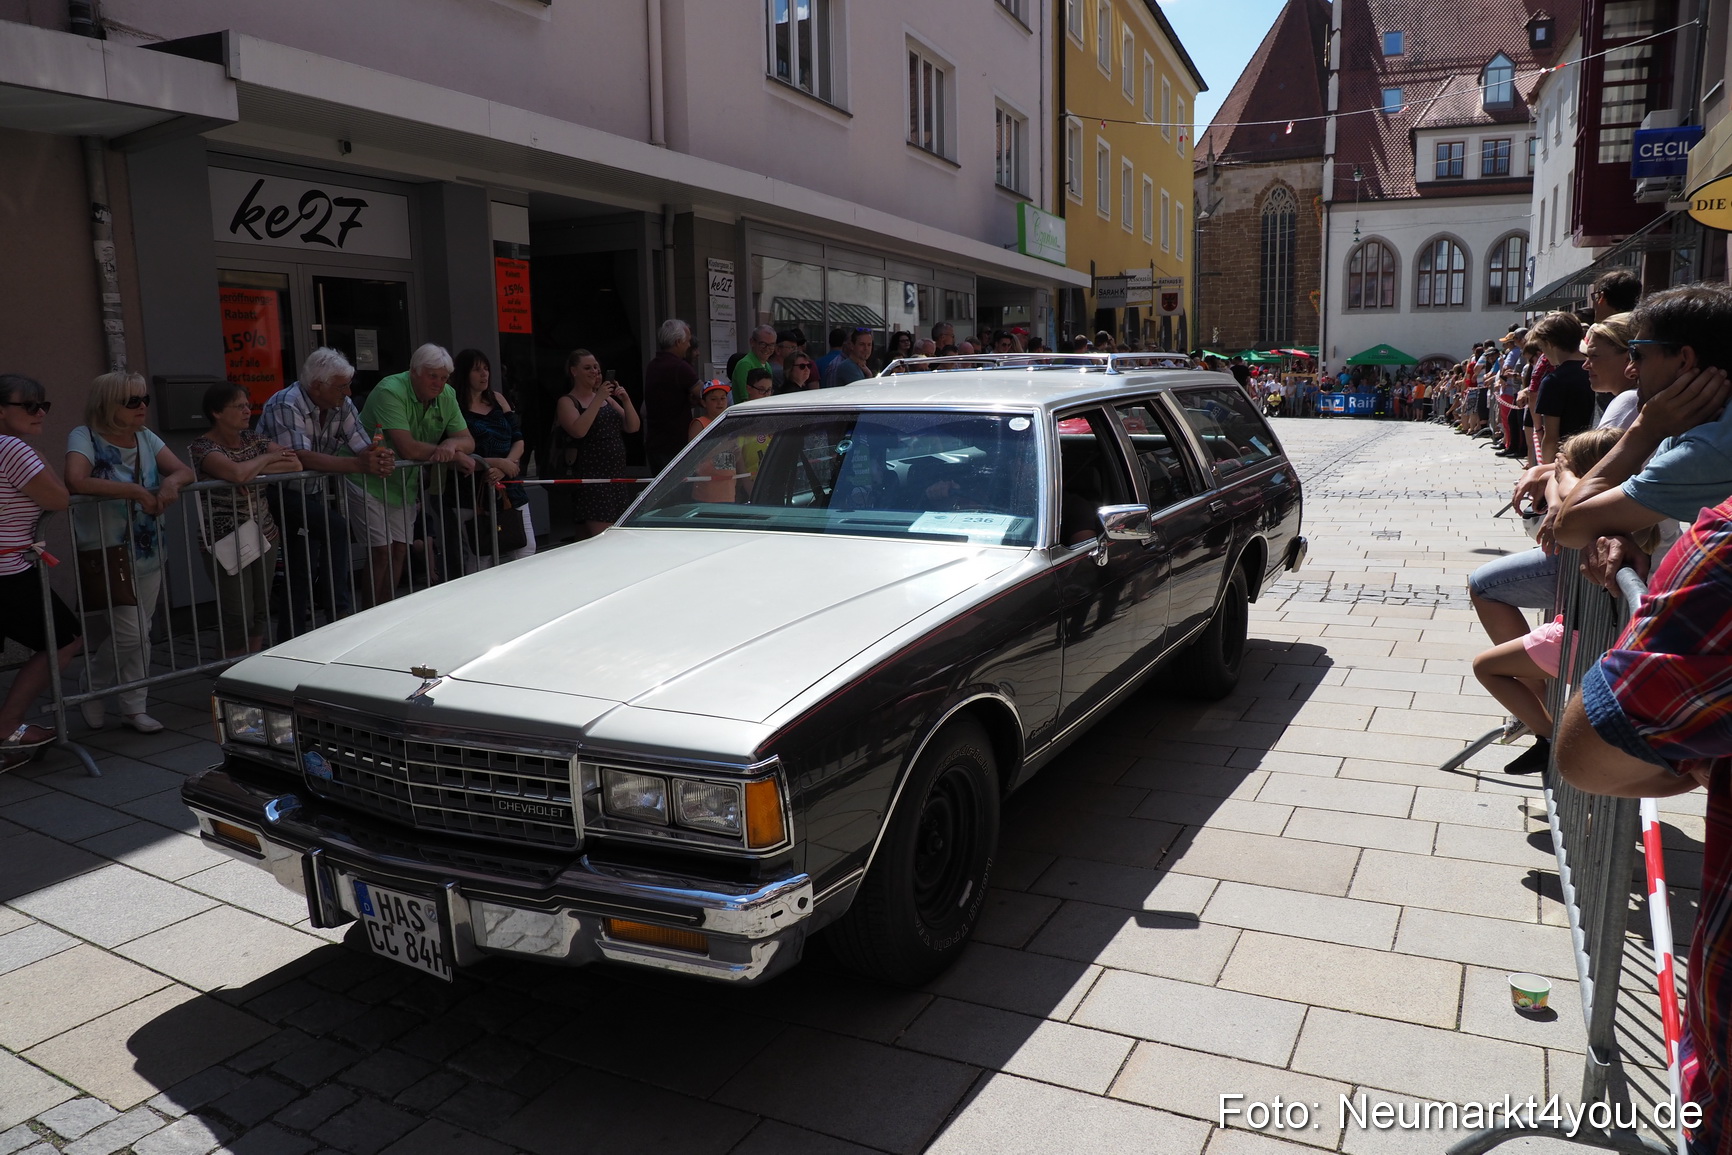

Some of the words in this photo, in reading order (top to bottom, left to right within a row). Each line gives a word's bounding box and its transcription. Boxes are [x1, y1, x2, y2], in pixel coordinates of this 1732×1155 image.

[1639, 141, 1689, 157] CECIL
[1696, 198, 1727, 211] DIE
[229, 178, 369, 249] ke27
[504, 284, 523, 296] 15%
[710, 275, 733, 292] ke27
[219, 291, 273, 305] eröffnungs-
[1098, 288, 1119, 296] SARAH
[1120, 287, 1125, 295] K
[224, 309, 258, 320] Rabatt
[222, 329, 267, 354] 15%
[230, 356, 244, 368] auf
[246, 356, 260, 368] alle
[498, 800, 565, 818] CHEVROLET
[363, 902, 371, 912] D
[375, 891, 426, 932] HAS
[367, 920, 400, 956] CC
[403, 931, 448, 976] 84H
